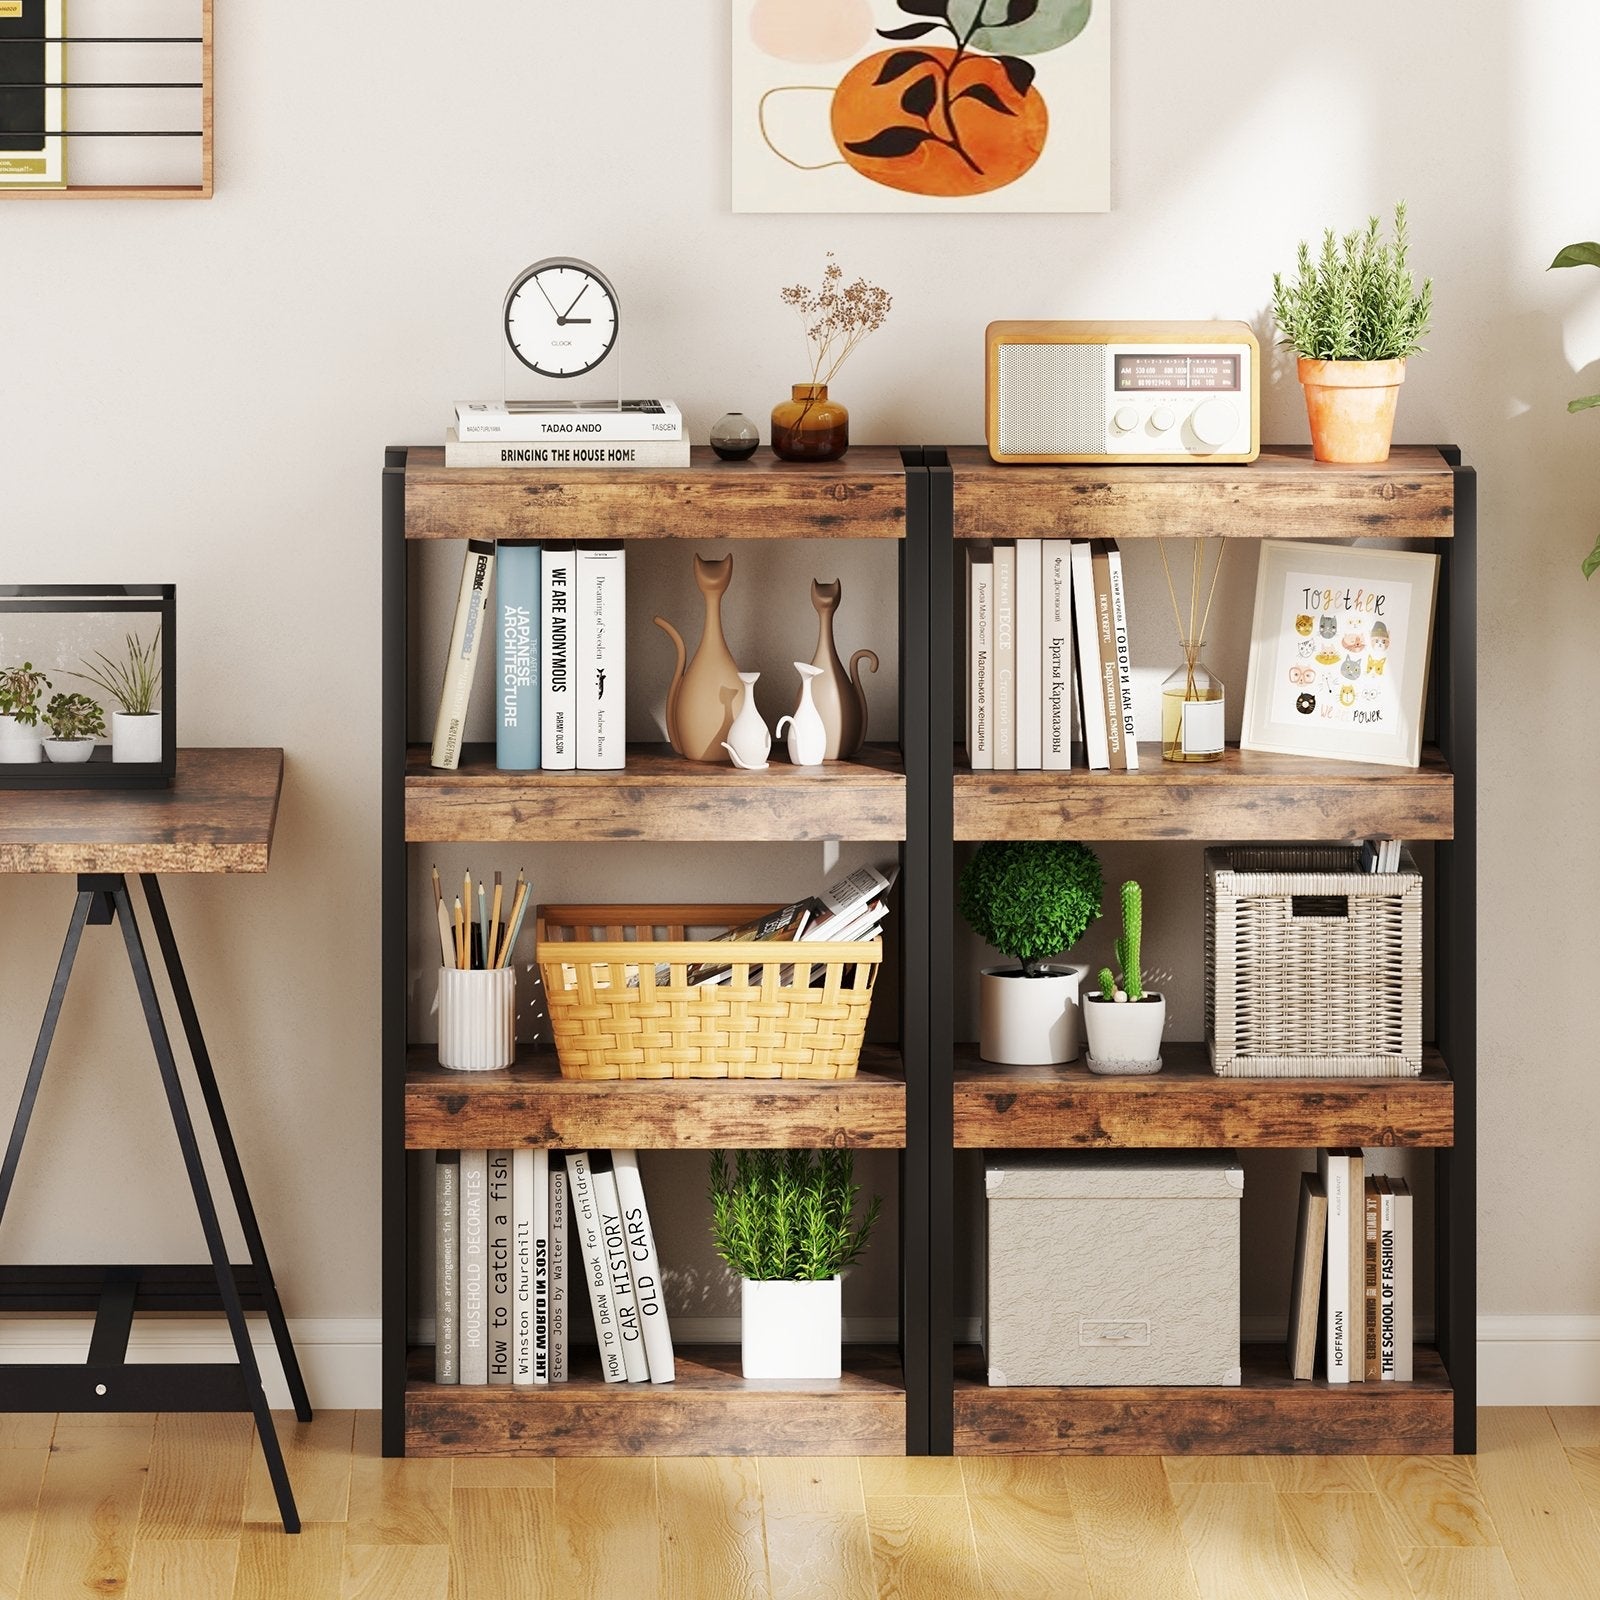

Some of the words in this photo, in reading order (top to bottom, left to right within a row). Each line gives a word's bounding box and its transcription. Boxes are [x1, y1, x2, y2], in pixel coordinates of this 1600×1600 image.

[541, 424, 573, 433] TADAO
[575, 424, 602, 433] ANDO
[501, 450, 548, 462] BRINGING
[551, 450, 569, 462] THE
[573, 450, 605, 462] HOUSE
[608, 450, 635, 462] HOME
[552, 568, 566, 586] WE
[552, 591, 566, 613] ARE
[594, 576, 605, 616] Dreaming
[596, 618, 605, 627] of
[999, 608, 1010, 650] ГЕССЕ
[517, 607, 529, 686] JAPANESE
[552, 617, 566, 692] ANONYMOUS
[596, 628, 605, 659] Sweden
[1049, 638, 1064, 678] Братья
[1116, 627, 1131, 683] ГОВОРИ
[505, 605, 517, 727] ARCHITECTURE
[978, 651, 986, 704] Маленькие
[1104, 662, 1116, 716] Бархатная
[1122, 688, 1132, 710] КАК
[597, 709, 605, 734] Andrew
[977, 706, 985, 751] женщины
[1049, 682, 1064, 753] Карамазовы
[1124, 716, 1134, 736] БОГ
[597, 736, 605, 757] Brown
[1109, 718, 1119, 753] смерть
[443, 1169, 452, 1196] house
[491, 1158, 507, 1202] fish
[574, 1159, 592, 1219] children
[443, 1201, 452, 1216] the
[467, 1170, 480, 1254] DECORATES
[552, 1174, 562, 1230] Isaacson
[443, 1222, 452, 1232] in
[494, 1216, 507, 1225] a
[625, 1208, 649, 1261] CARS
[1366, 1212, 1376, 1240] ROWLING
[586, 1228, 597, 1249] for
[603, 1213, 631, 1294] HISTORY
[1382, 1230, 1393, 1280] FASHION
[443, 1238, 454, 1296] arrangement
[491, 1238, 507, 1294] catch
[518, 1220, 529, 1301] Churchill
[552, 1238, 562, 1279] Walter
[590, 1257, 604, 1286] Book
[1366, 1264, 1376, 1286] POTTER
[444, 1301, 452, 1312] an
[467, 1264, 480, 1347] HOUSEHOLD
[552, 1287, 564, 1300] by
[638, 1276, 659, 1316] OLD
[1382, 1283, 1393, 1298] OF
[492, 1307, 507, 1328] to
[552, 1308, 562, 1336] Jobs
[597, 1294, 611, 1324] DRAW
[619, 1305, 639, 1341] CAR
[1382, 1301, 1393, 1347] SCHOOL
[443, 1317, 452, 1339] make
[519, 1311, 529, 1374] Winston
[604, 1331, 615, 1347] TO
[1335, 1311, 1343, 1366] HOFFMANN
[443, 1344, 452, 1354] to
[491, 1341, 507, 1375] How
[553, 1343, 562, 1378] Steve
[608, 1353, 620, 1377] HOW
[1382, 1350, 1393, 1373] THE
[443, 1360, 452, 1376] How
